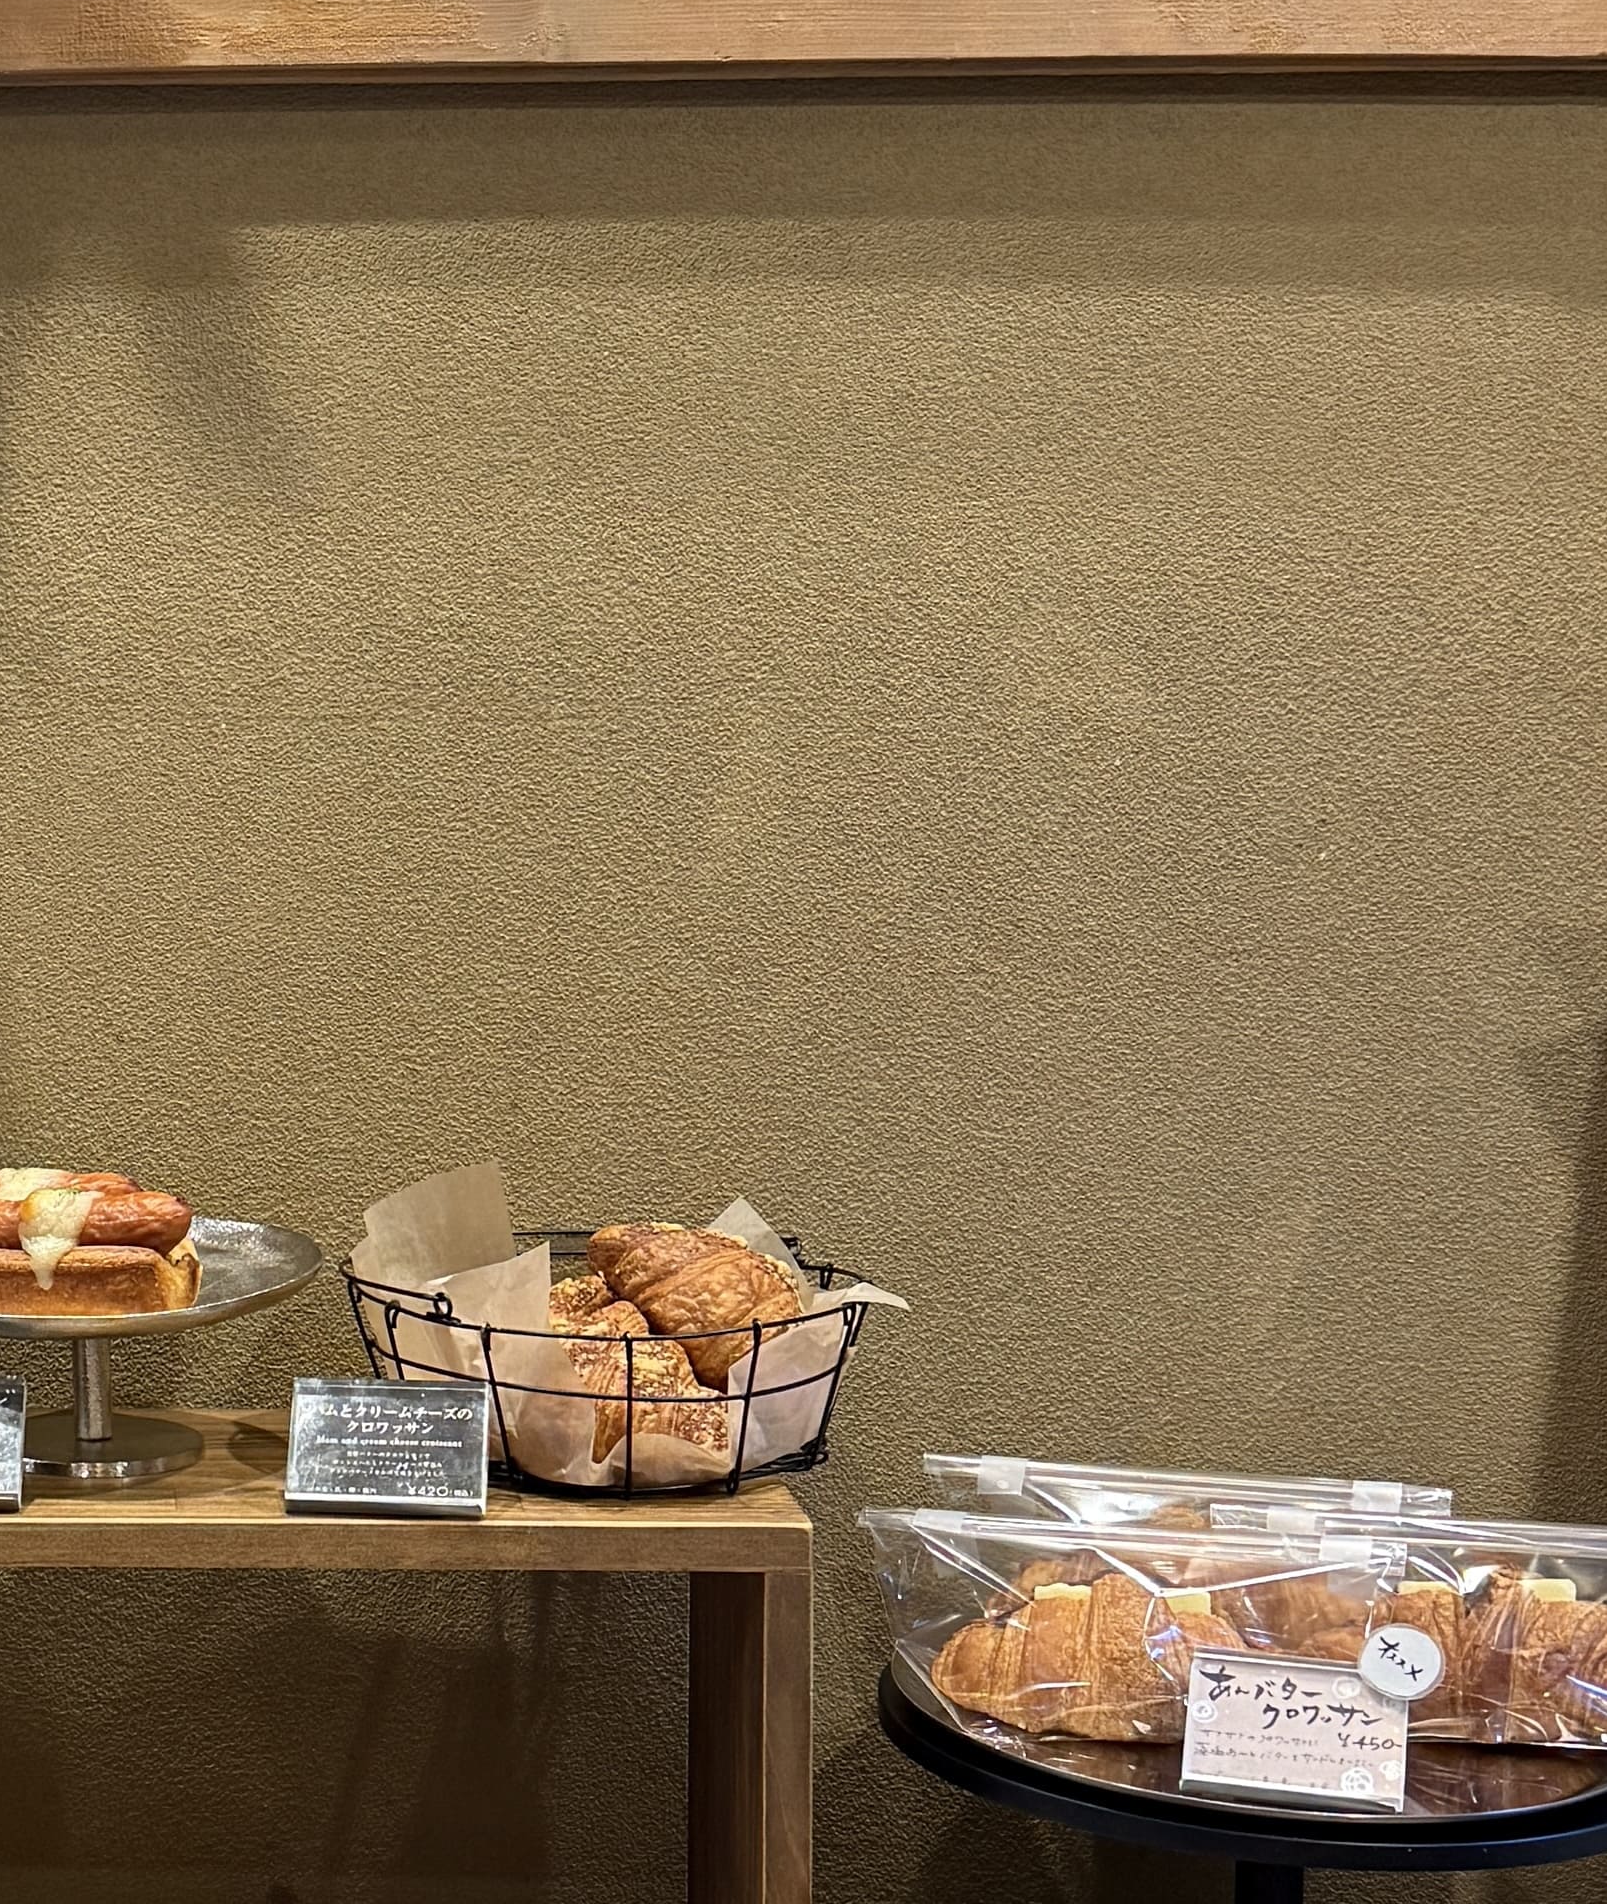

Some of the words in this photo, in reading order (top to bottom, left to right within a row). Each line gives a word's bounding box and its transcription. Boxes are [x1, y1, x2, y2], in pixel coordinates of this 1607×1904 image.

[346, 1420, 434, 1435] クロワッサン
[340, 1435, 358, 1446] and
[360, 1437, 387, 1447] cream
[389, 1437, 419, 1447] cheese
[421, 1439, 463, 1449] croissant
[1199, 1666, 1323, 1702] あんバター
[1262, 1703, 1384, 1729] クロワッサン
